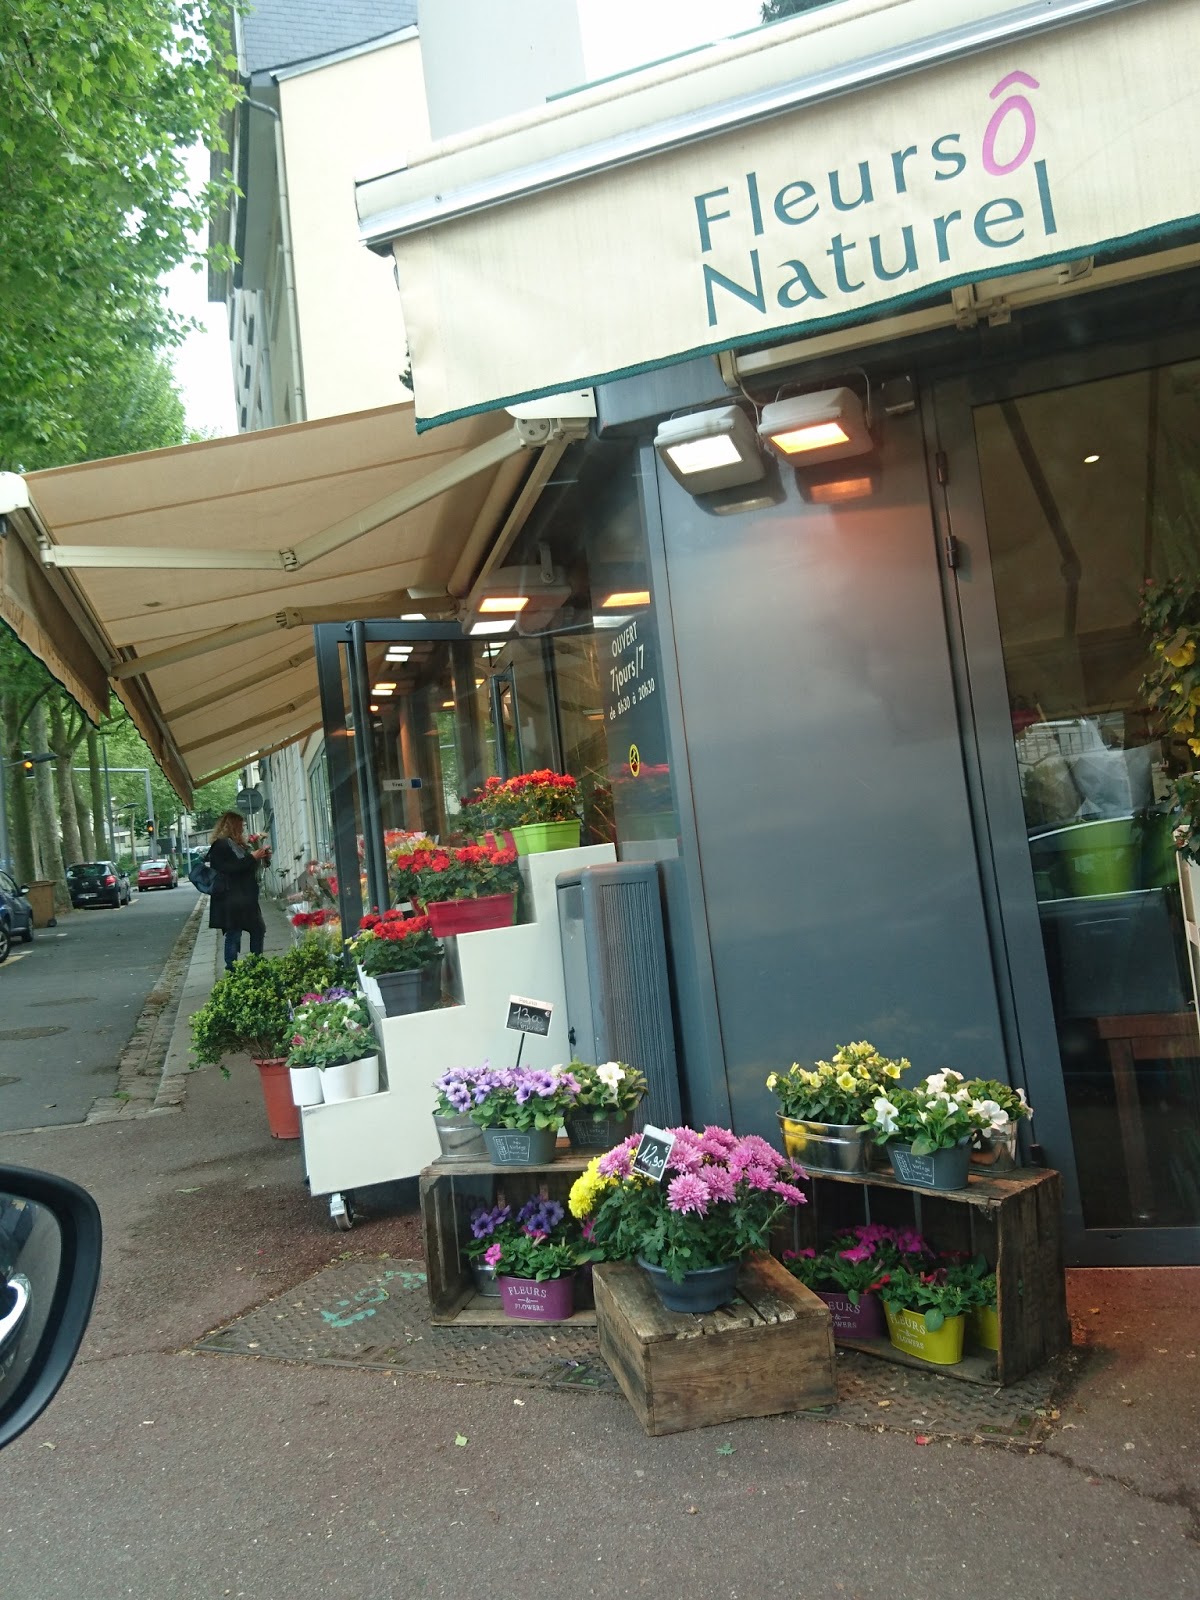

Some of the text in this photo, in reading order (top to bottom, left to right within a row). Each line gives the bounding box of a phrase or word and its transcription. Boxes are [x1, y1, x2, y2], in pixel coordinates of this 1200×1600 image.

[694, 70, 1040, 253] Fleurs Ô
[702, 158, 1058, 327] Naturel
[611, 621, 638, 657] OUVERT
[609, 677, 655, 721] de 8h30 à 20h30
[507, 1285, 547, 1298] FLEURS
[514, 1303, 545, 1311] FLOWERS
[828, 1301, 861, 1314] EURS
